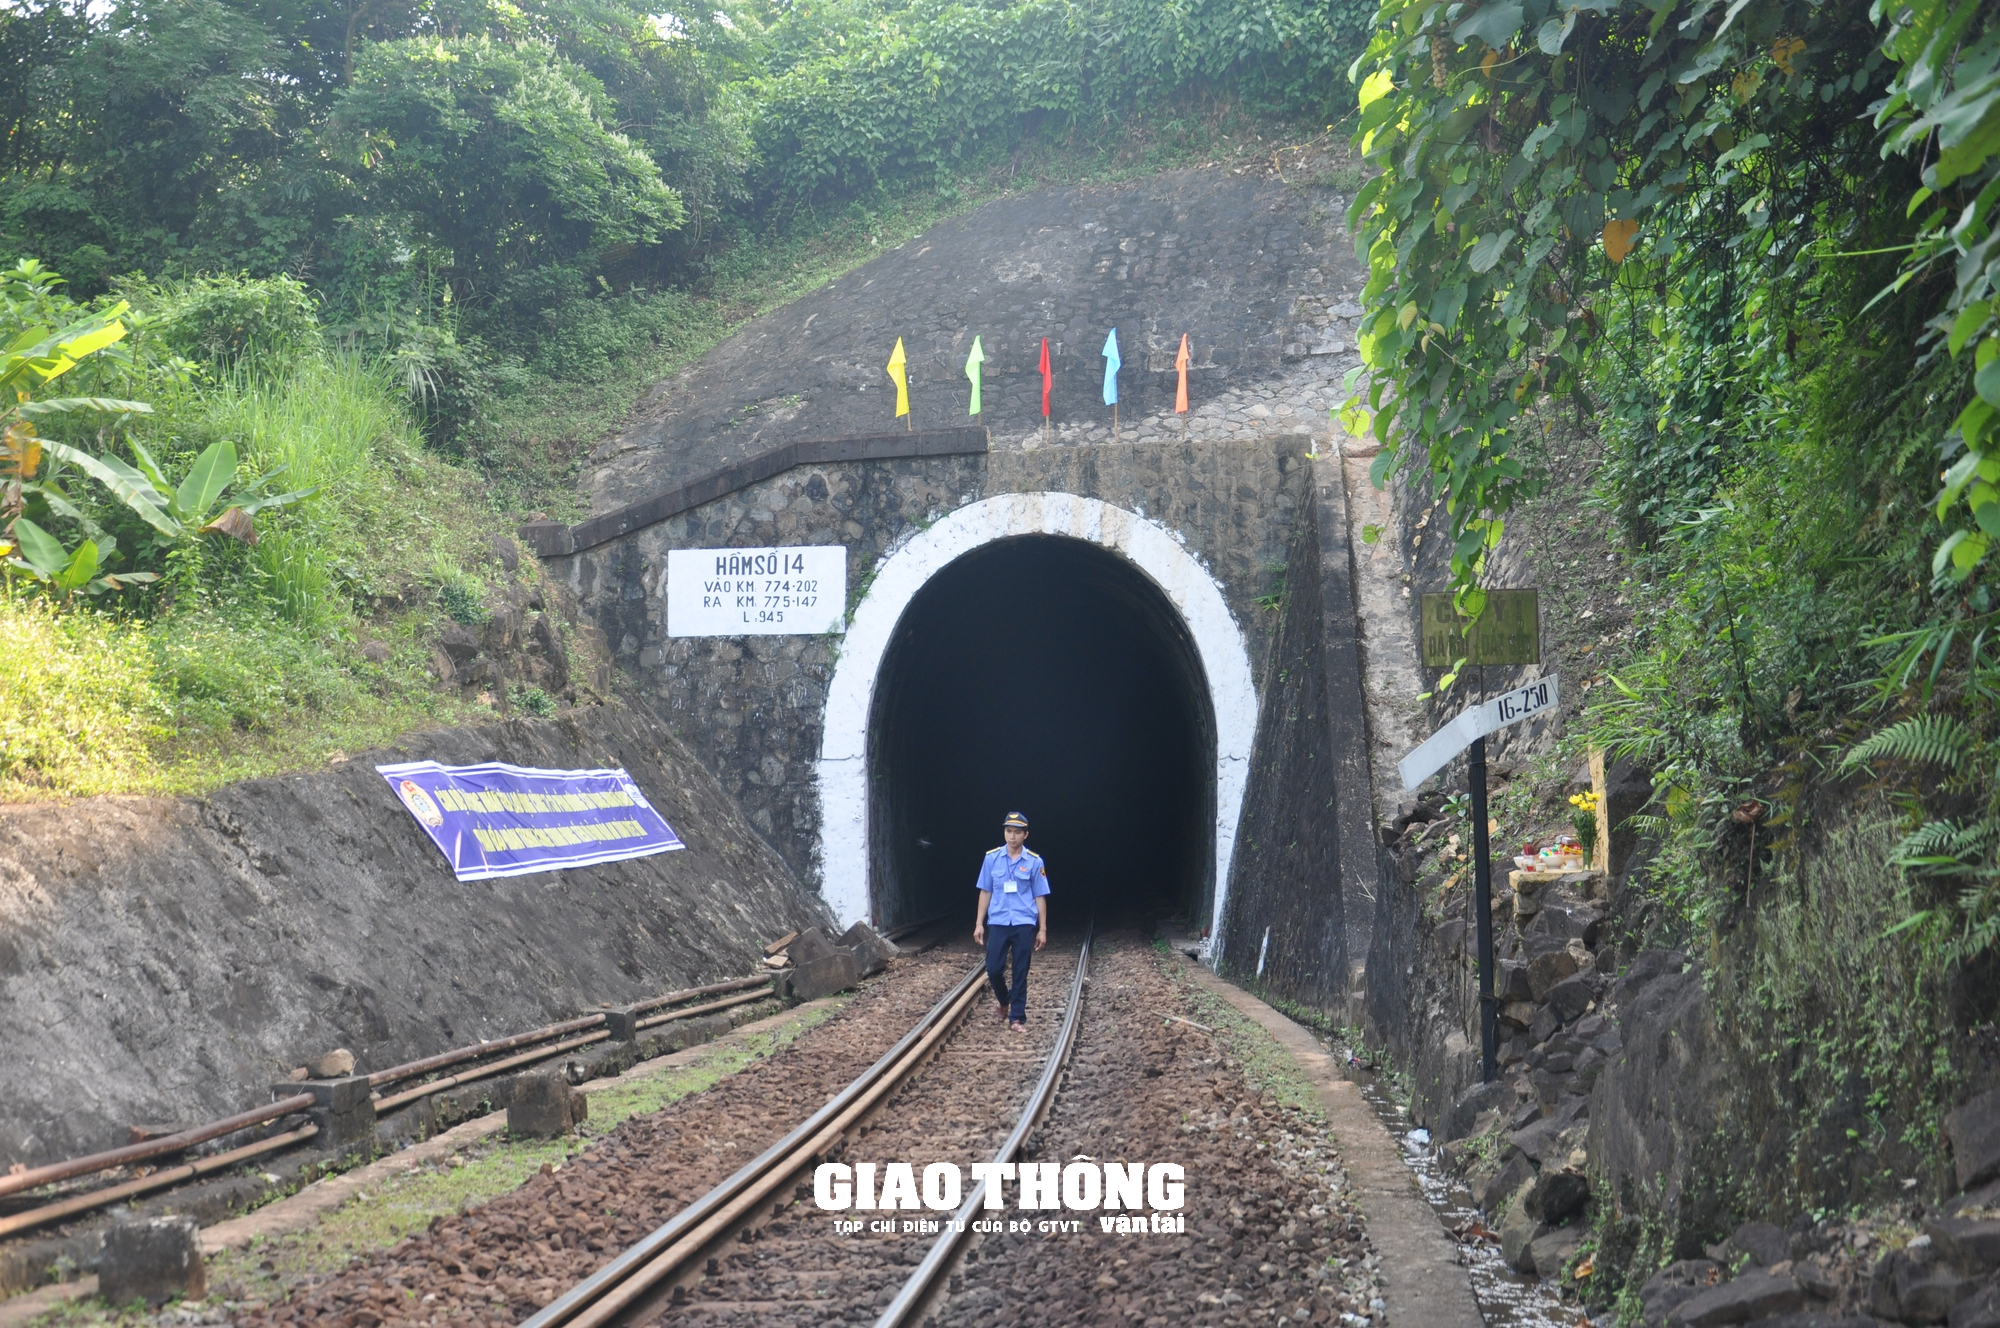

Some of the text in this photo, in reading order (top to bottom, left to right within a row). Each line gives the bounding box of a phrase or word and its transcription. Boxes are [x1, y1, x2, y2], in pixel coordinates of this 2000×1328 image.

[784, 554, 804, 575] 14
[704, 577, 731, 593] VÀO
[703, 595, 722, 608] RA
[1498, 683, 1549, 722] 16-250
